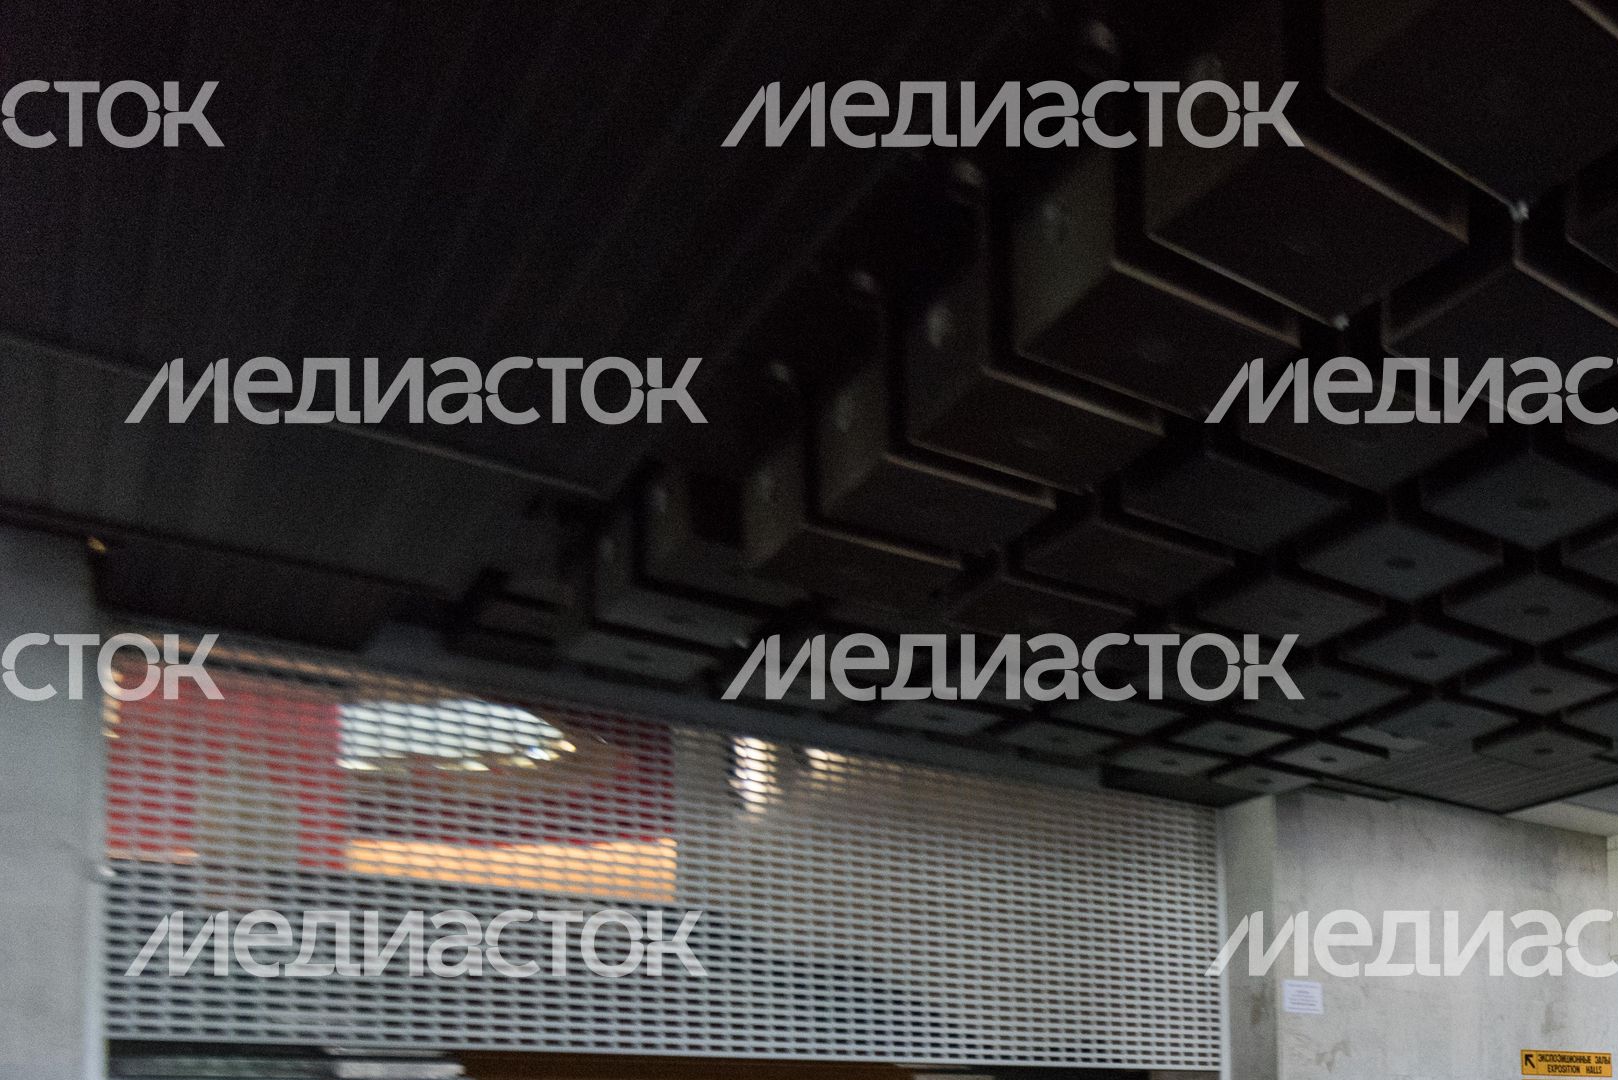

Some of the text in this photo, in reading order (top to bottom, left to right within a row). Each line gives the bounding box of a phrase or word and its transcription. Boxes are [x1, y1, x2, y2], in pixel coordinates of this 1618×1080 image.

[1595, 1056, 1611, 1065] ЗАЛЫ
[1547, 1064, 1602, 1075] EXPOSITION HALLS
